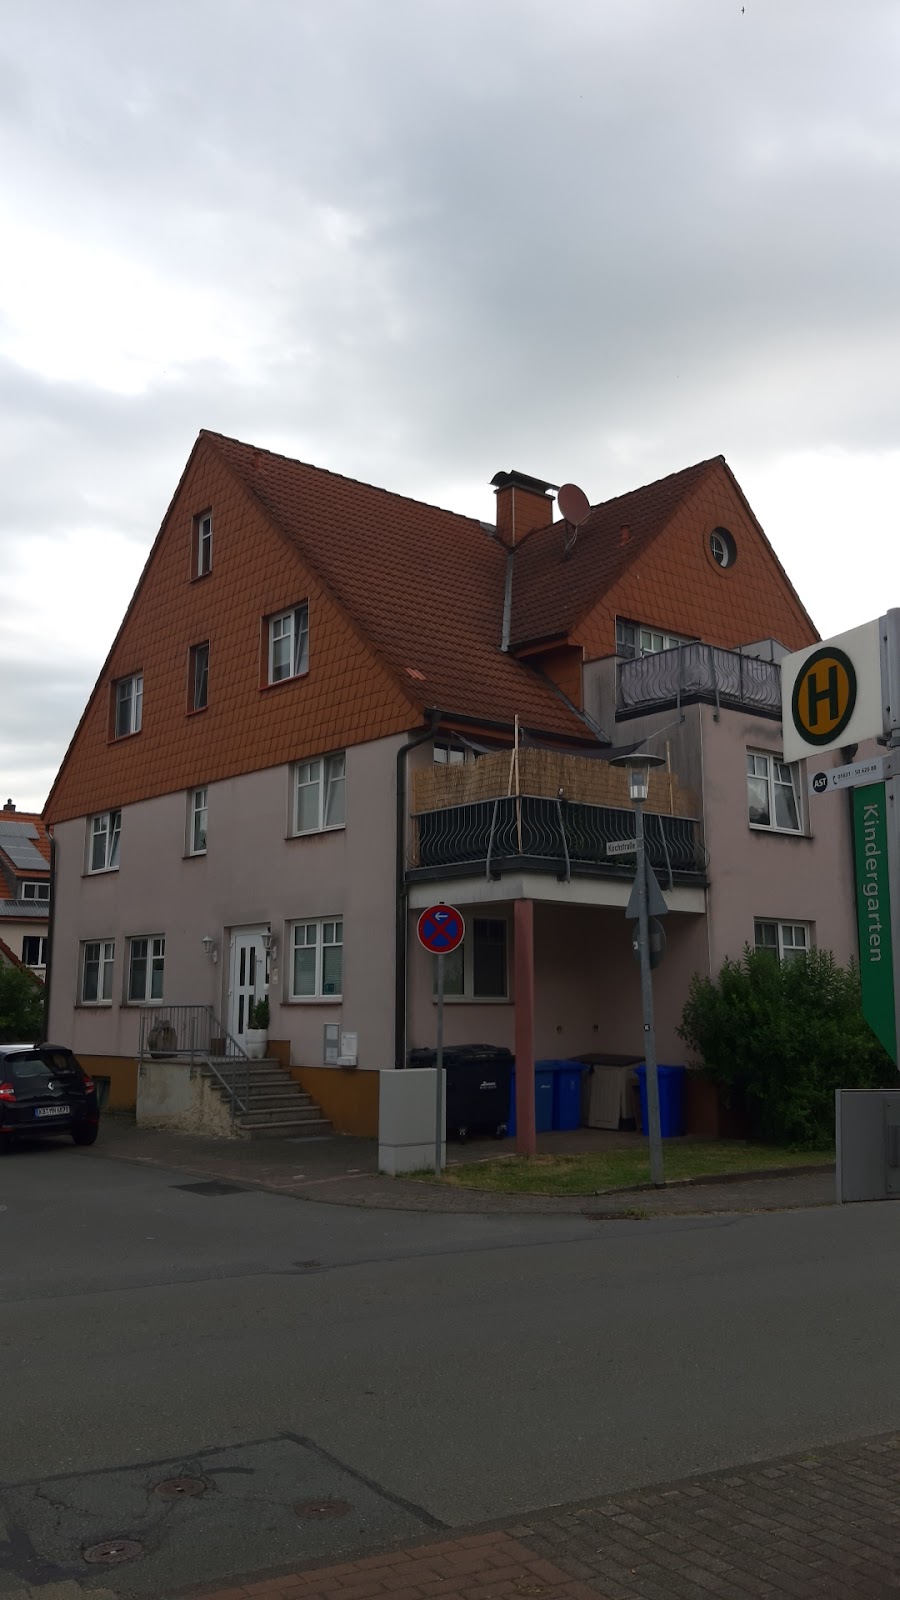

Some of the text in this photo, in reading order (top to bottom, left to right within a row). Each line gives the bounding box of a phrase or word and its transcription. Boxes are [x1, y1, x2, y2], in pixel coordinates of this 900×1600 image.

[807, 664, 839, 727] H
[814, 777, 827, 788] AST
[608, 841, 636, 852] Kirchstraße
[863, 803, 882, 962] Kindergarten
